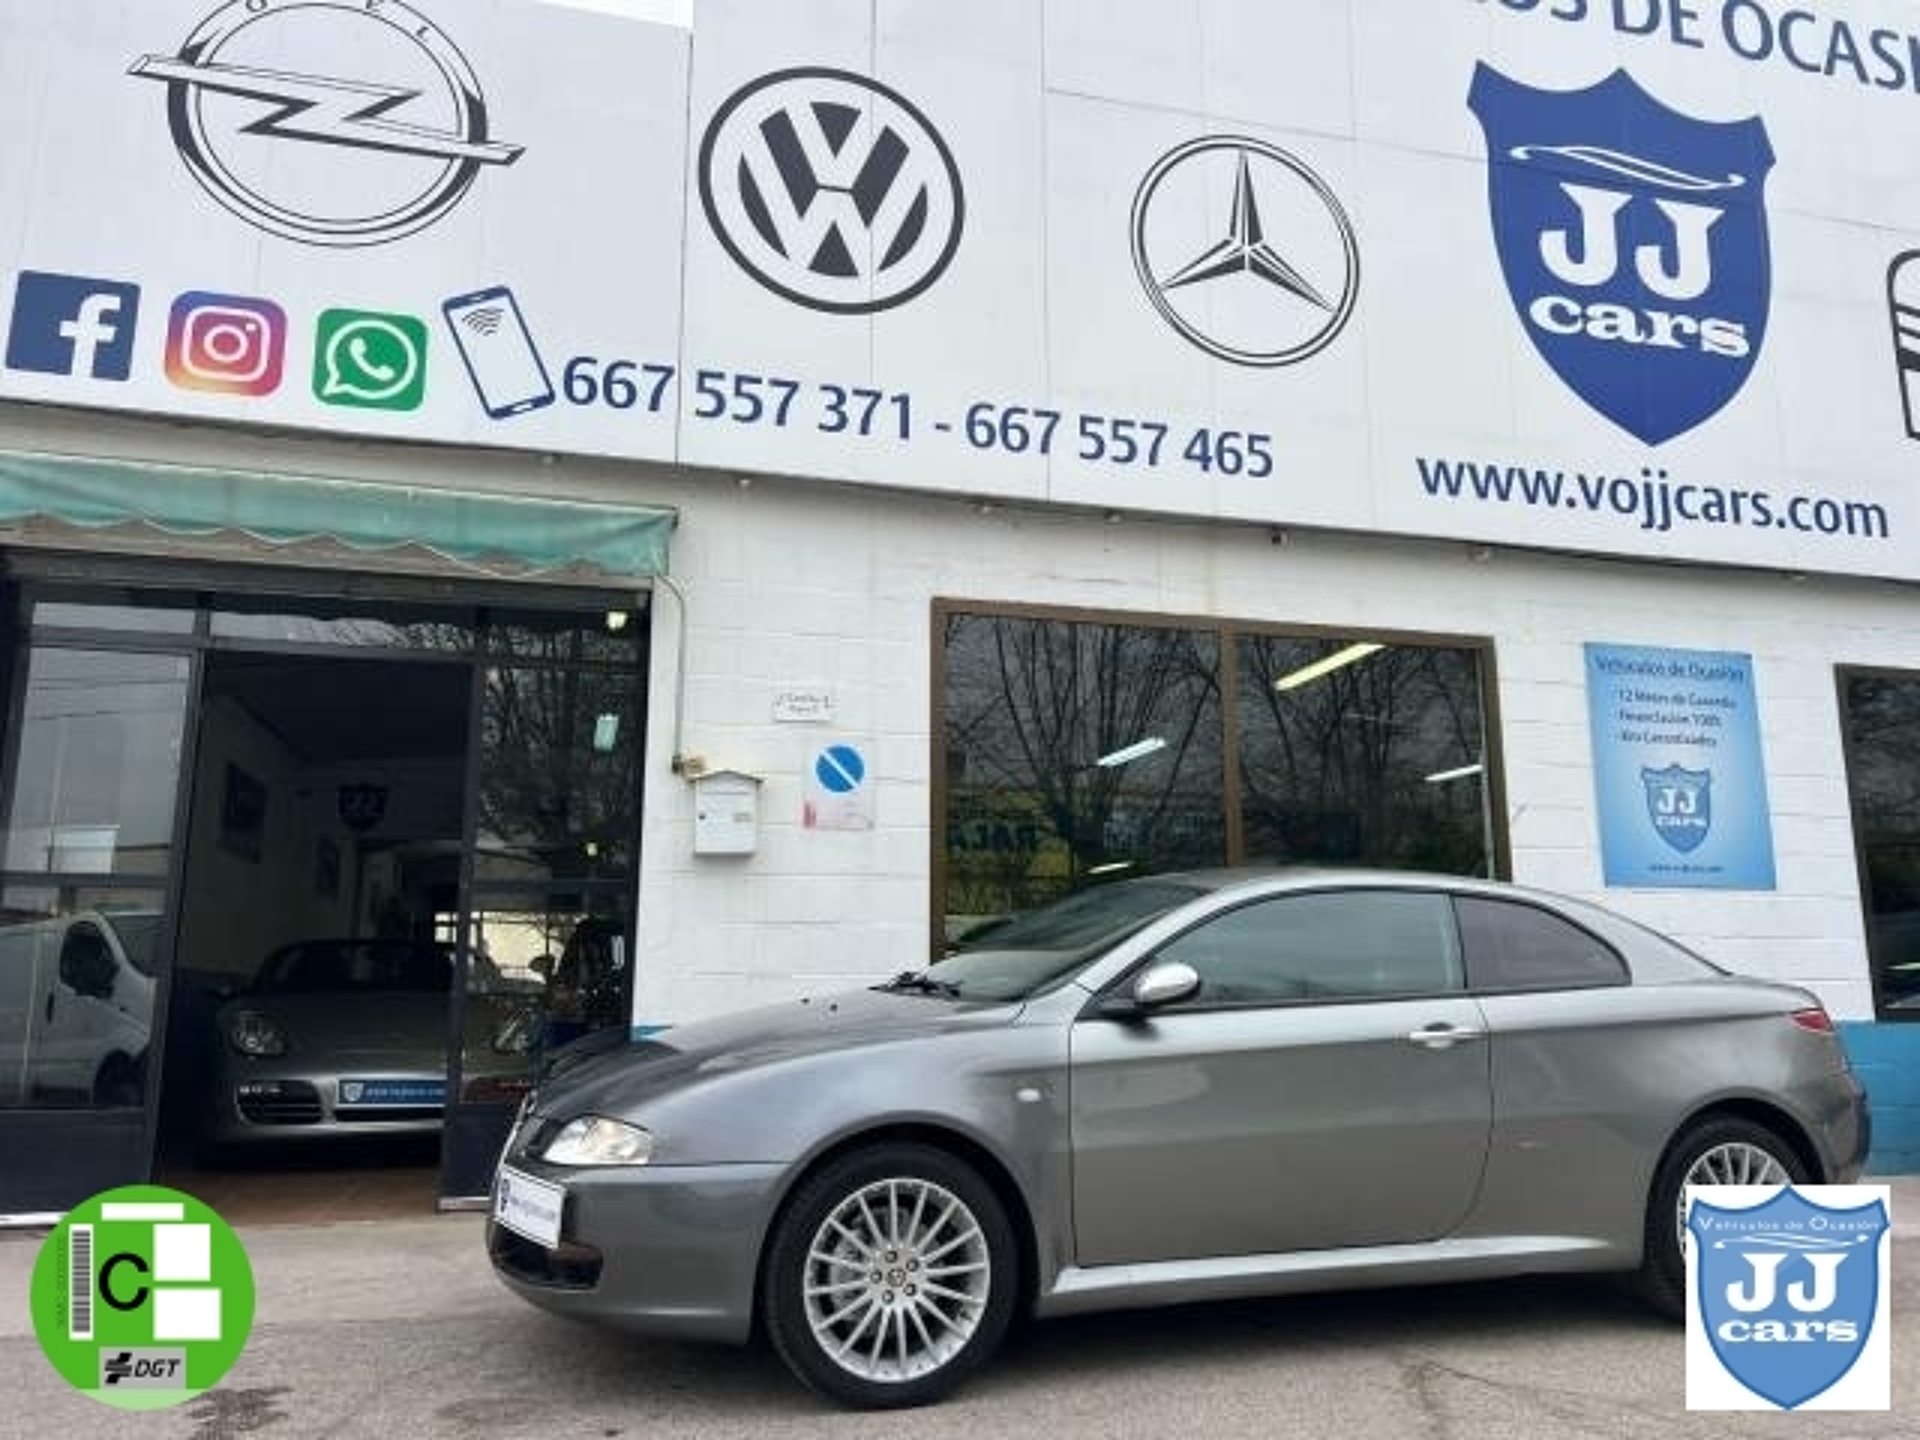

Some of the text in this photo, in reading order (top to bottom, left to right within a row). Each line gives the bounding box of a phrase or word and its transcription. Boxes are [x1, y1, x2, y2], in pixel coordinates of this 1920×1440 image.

[1529, 296, 1750, 357] cars
[563, 356, 676, 412] 667
[695, 369, 799, 427] 557
[818, 384, 911, 440] 371
[966, 403, 1061, 455] 667
[1079, 414, 1169, 467] 557
[1183, 428, 1274, 478] 465
[1416, 457, 1889, 538] www.vojjcars.com
